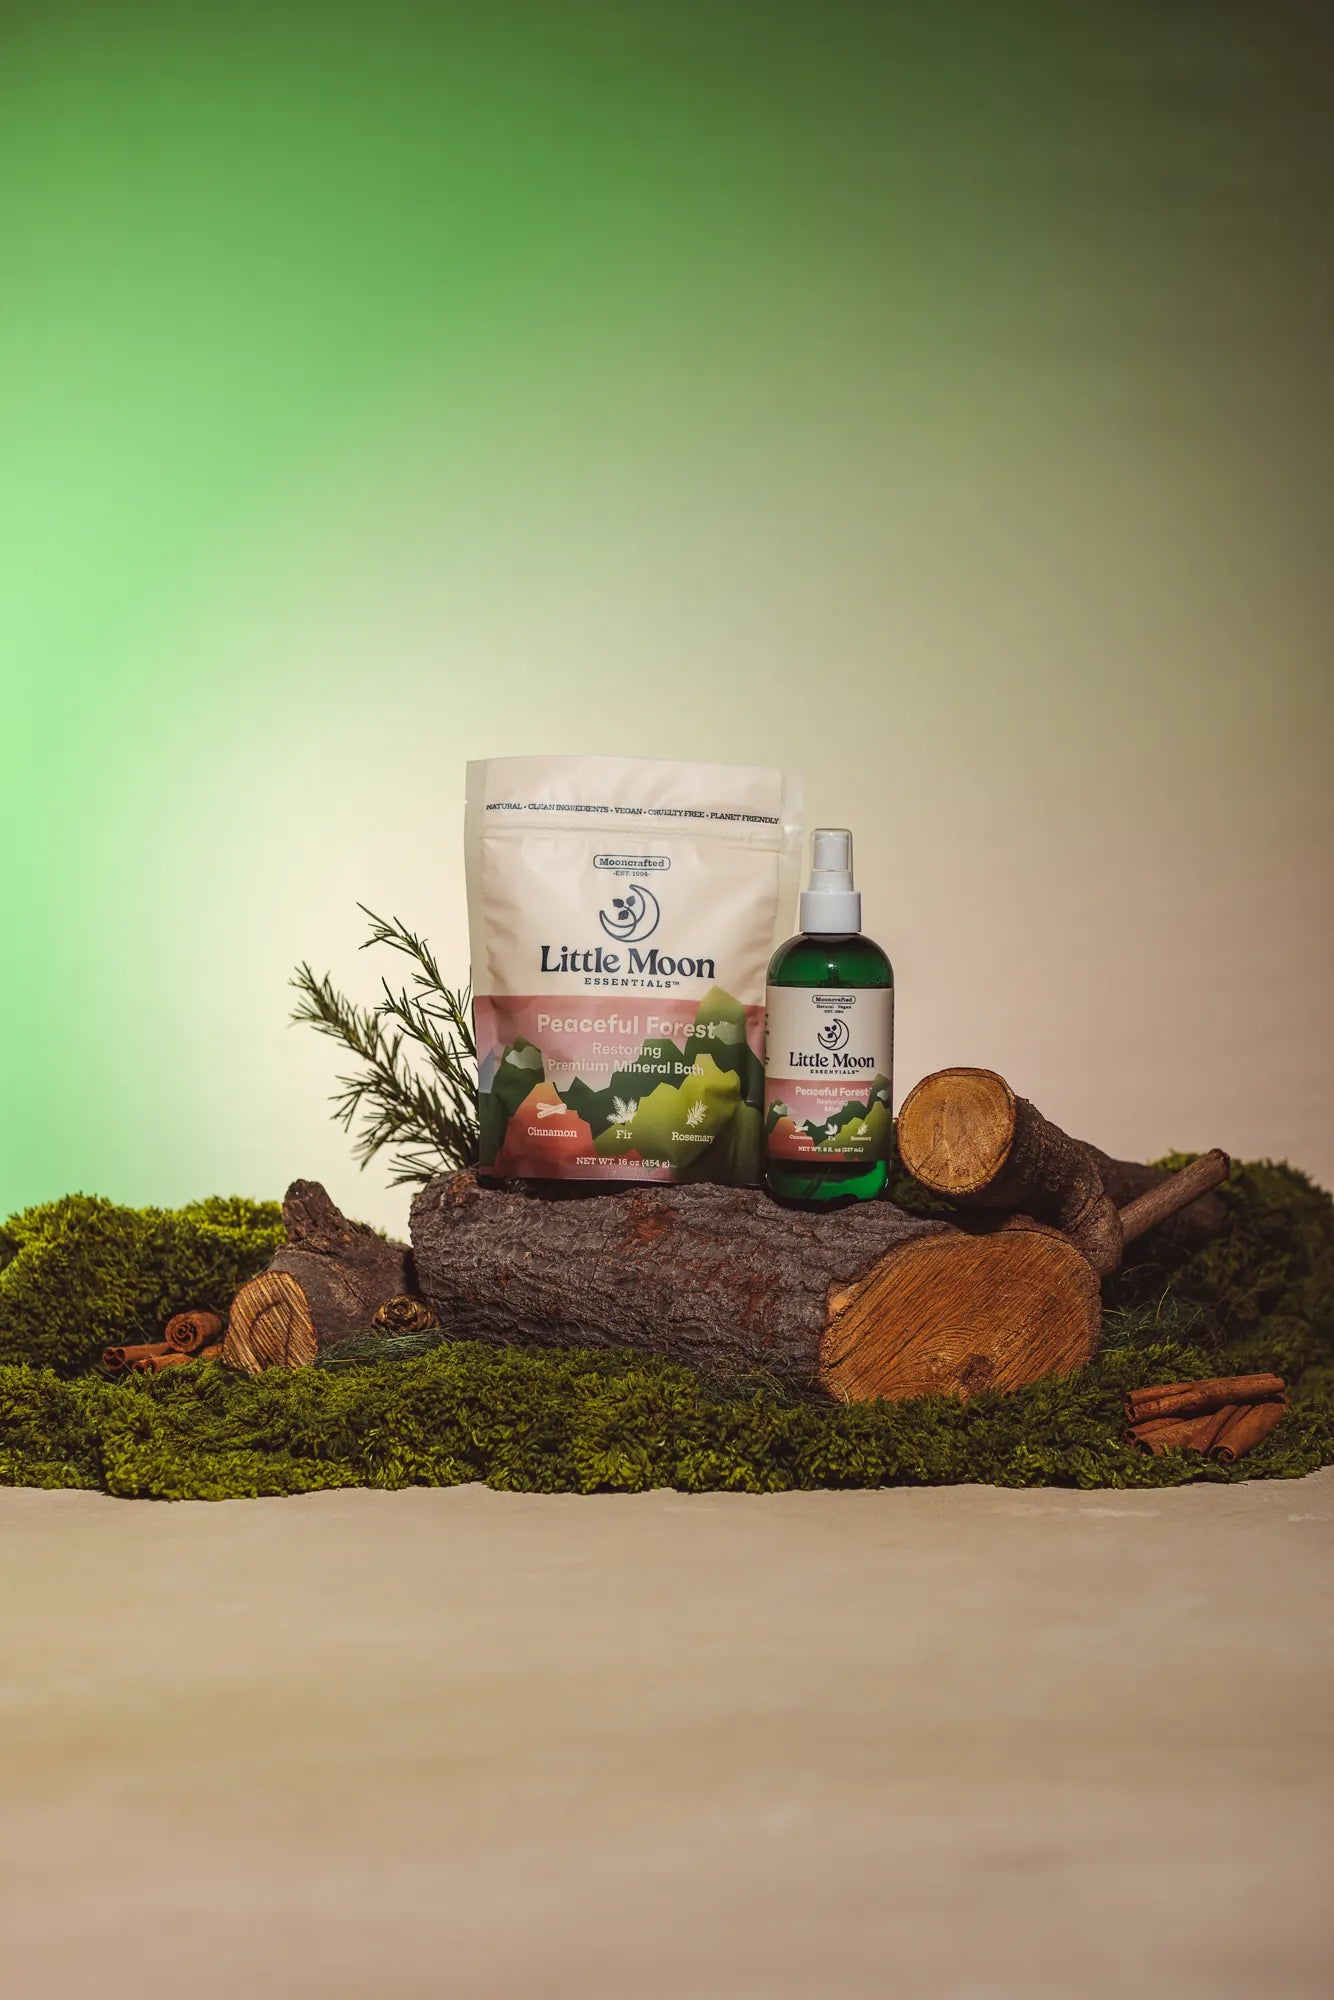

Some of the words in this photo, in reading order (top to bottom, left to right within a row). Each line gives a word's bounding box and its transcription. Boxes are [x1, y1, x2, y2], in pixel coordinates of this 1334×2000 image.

[486, 803, 523, 811] NATURAL
[527, 803, 555, 811] CLEAN
[555, 804, 609, 813] INGREDIENTS
[614, 807, 643, 815] VEGAN
[648, 809, 684, 817] CRUELTY
[684, 810, 705, 818] FREE
[710, 812, 741, 821] PLANET
[741, 814, 779, 825] FRIENDLY
[599, 858, 665, 867] Mooncrafted
[541, 946, 620, 973] Little
[628, 949, 715, 978] Moon
[537, 1013, 639, 1034] Peaceful
[592, 1042, 662, 1059] Restoring
[547, 1058, 609, 1072] Premium
[613, 1060, 671, 1075] Mineral
[674, 1063, 705, 1076] Bath
[789, 1052, 829, 1067] Little
[833, 1054, 875, 1068] Moon
[795, 1086, 837, 1097] Peaceful
[527, 1126, 578, 1138] Cinnamon
[615, 1129, 633, 1139] Fir
[671, 1131, 715, 1144] Rosemary
[576, 1157, 596, 1165] NET
[598, 1157, 616, 1166] WT.
[618, 1158, 628, 1166] 16
[641, 1158, 660, 1168] (454
[661, 1159, 670, 1168] g)
